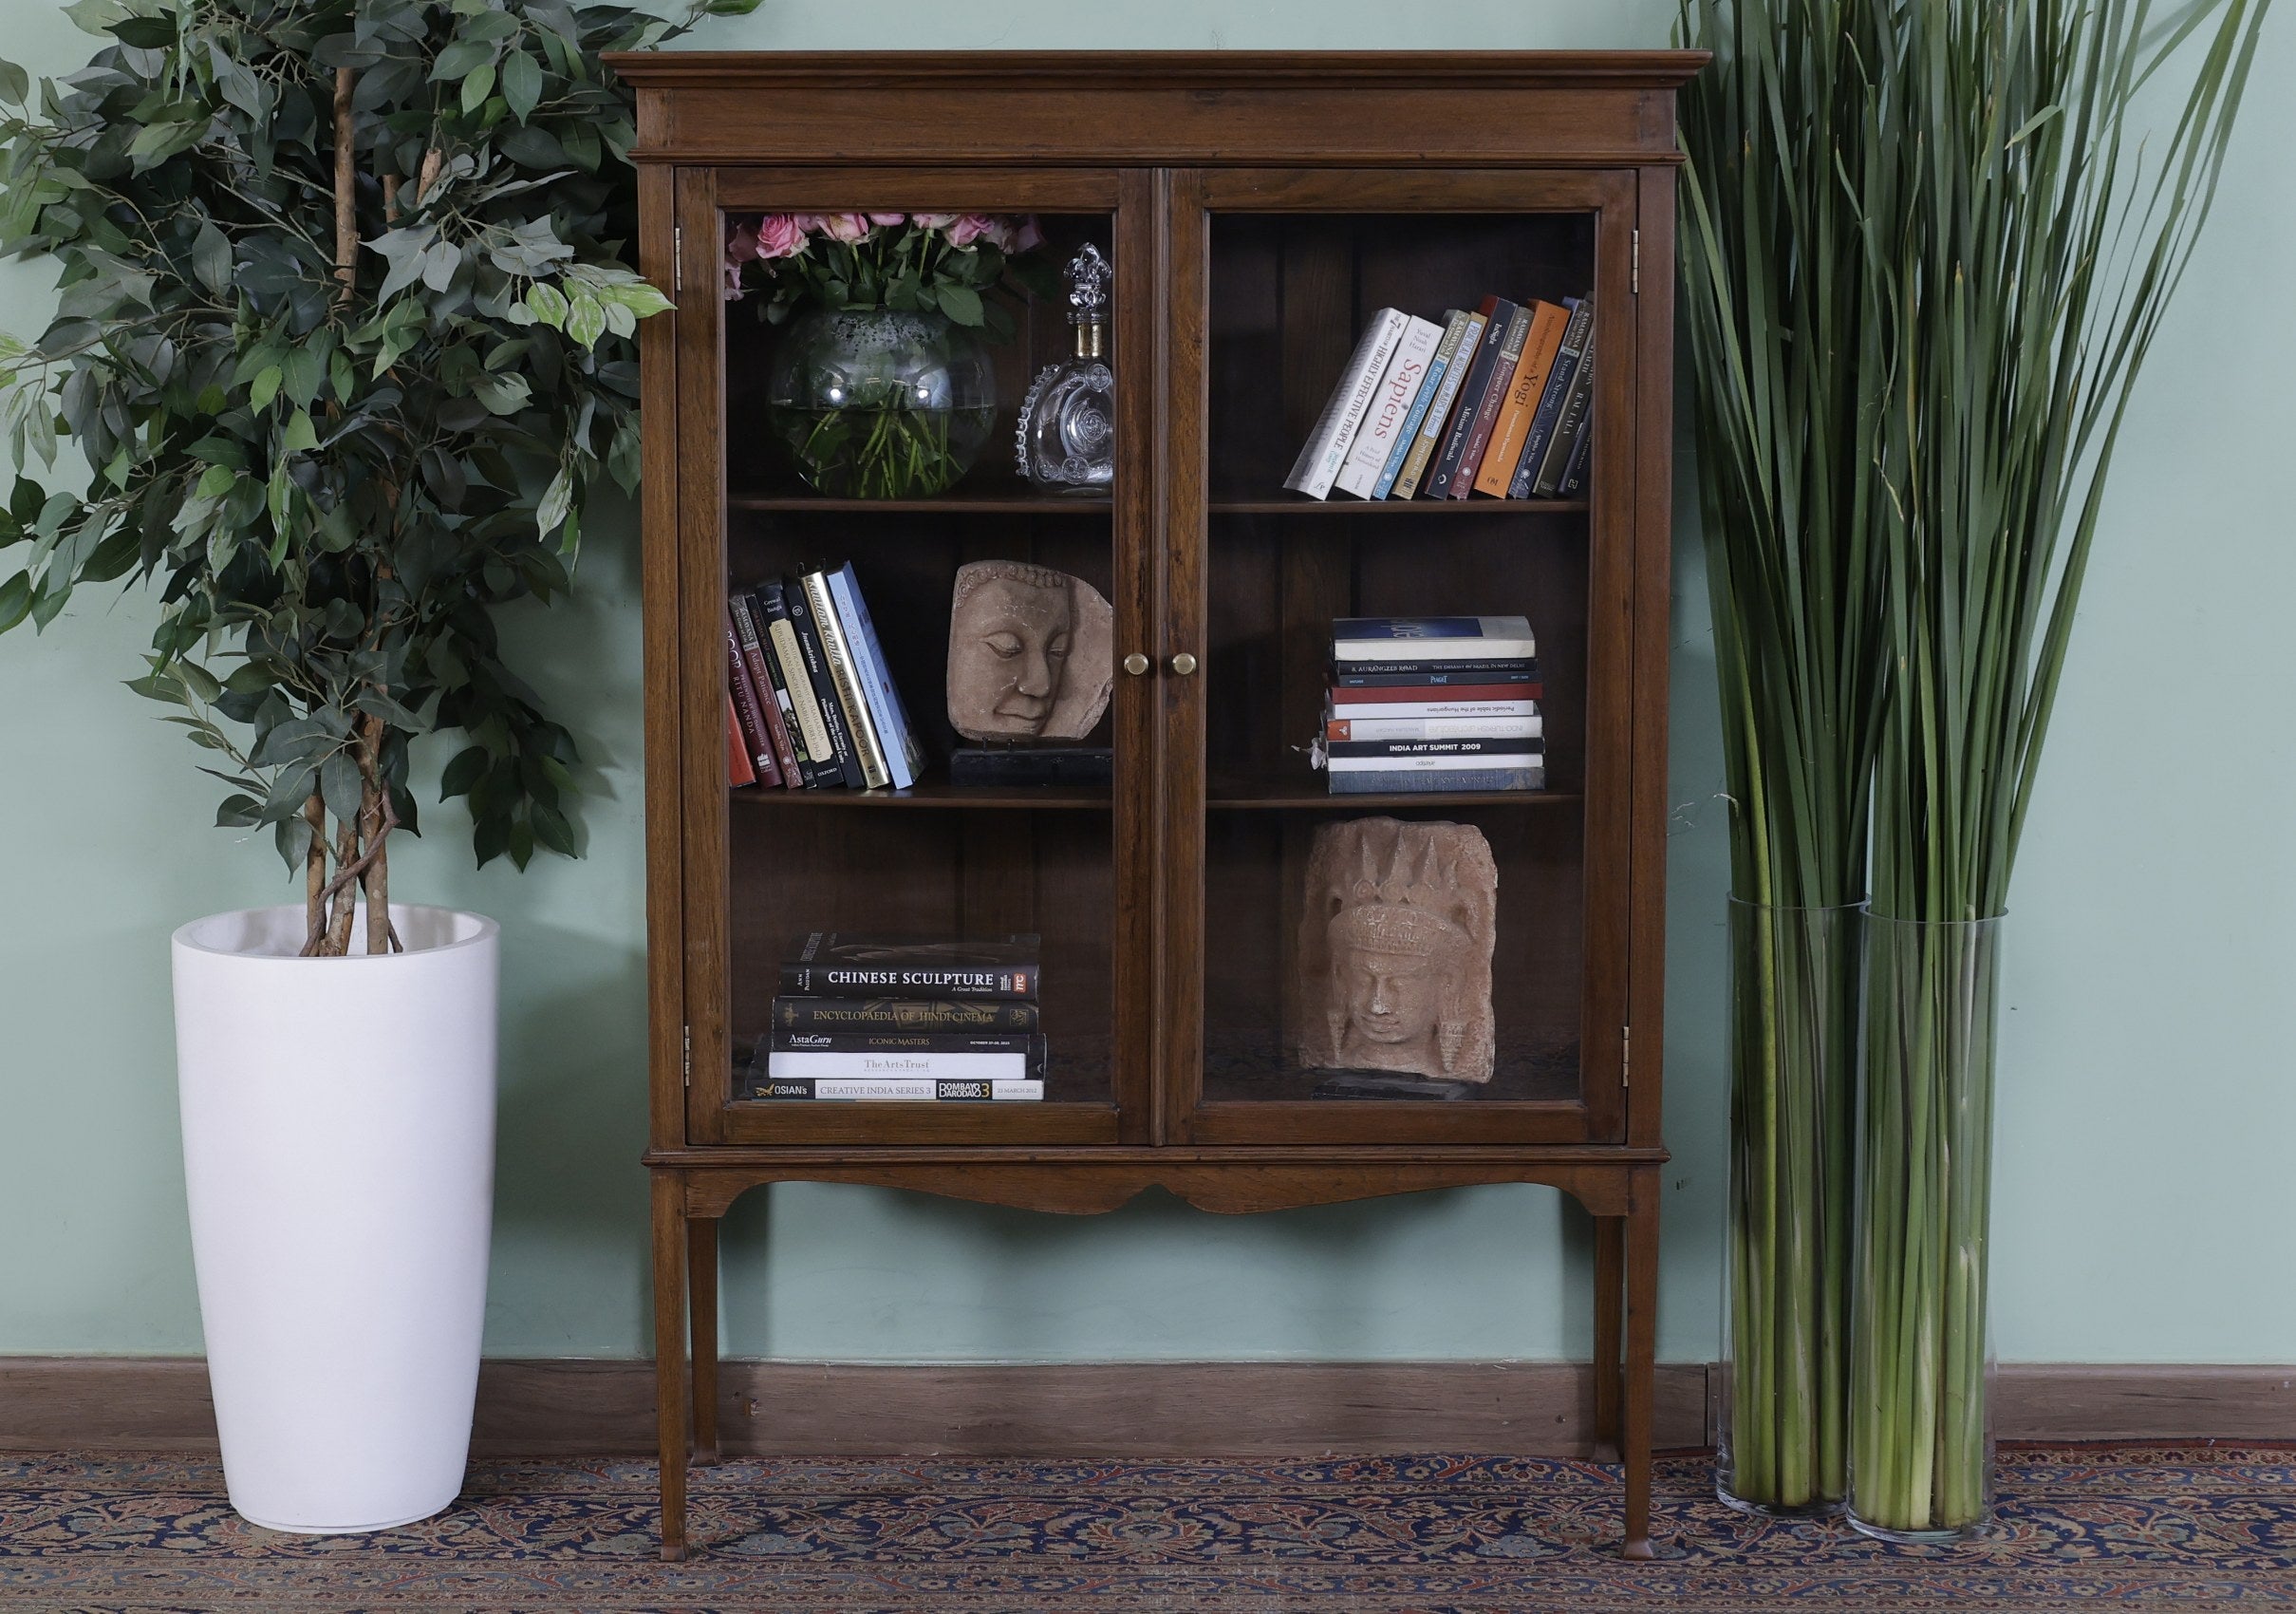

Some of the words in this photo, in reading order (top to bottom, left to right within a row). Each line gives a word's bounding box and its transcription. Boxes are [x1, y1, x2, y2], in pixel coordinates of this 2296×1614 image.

[1390, 319, 1401, 328] 7
[1486, 322, 1503, 346] InSight
[1367, 346, 1387, 375] HIGHLY
[1558, 360, 1570, 381] Stand
[1428, 366, 1442, 385] Roar
[1493, 362, 1509, 391] Conquer
[1349, 376, 1372, 419] EFFECTIVE
[1375, 359, 1421, 438] Sapiens
[1419, 385, 1431, 403] with
[1512, 375, 1538, 406] Yogi
[1546, 384, 1561, 408] Strong
[1405, 404, 1424, 434] Courage
[1456, 405, 1471, 430] Miriam
[1483, 393, 1499, 419] Change
[1335, 420, 1353, 448] PEOPLE
[801, 630, 819, 673] Jnanakrishna
[751, 652, 761, 674] Adopt
[758, 675, 771, 704] Patience
[788, 666, 800, 688] SINGH
[807, 579, 830, 629] Khullam
[822, 628, 842, 666] Khulla
[836, 667, 853, 701] RISHI
[847, 704, 868, 756] KAPOOR
[733, 676, 744, 697] RITU
[740, 701, 754, 733] NANDA
[810, 704, 825, 741] MAHARAJA
[828, 971, 897, 984] CHINESE
[903, 972, 994, 985] SCULPTURE
[813, 1011, 899, 1021] ENCYCLOPAEDIA
[901, 1011, 915, 1022] OF
[920, 1011, 950, 1022] HINDI
[952, 1012, 995, 1023] CINEMA
[789, 1034, 832, 1044] AstaGuru
[775, 1085, 808, 1095] OSIAN's
